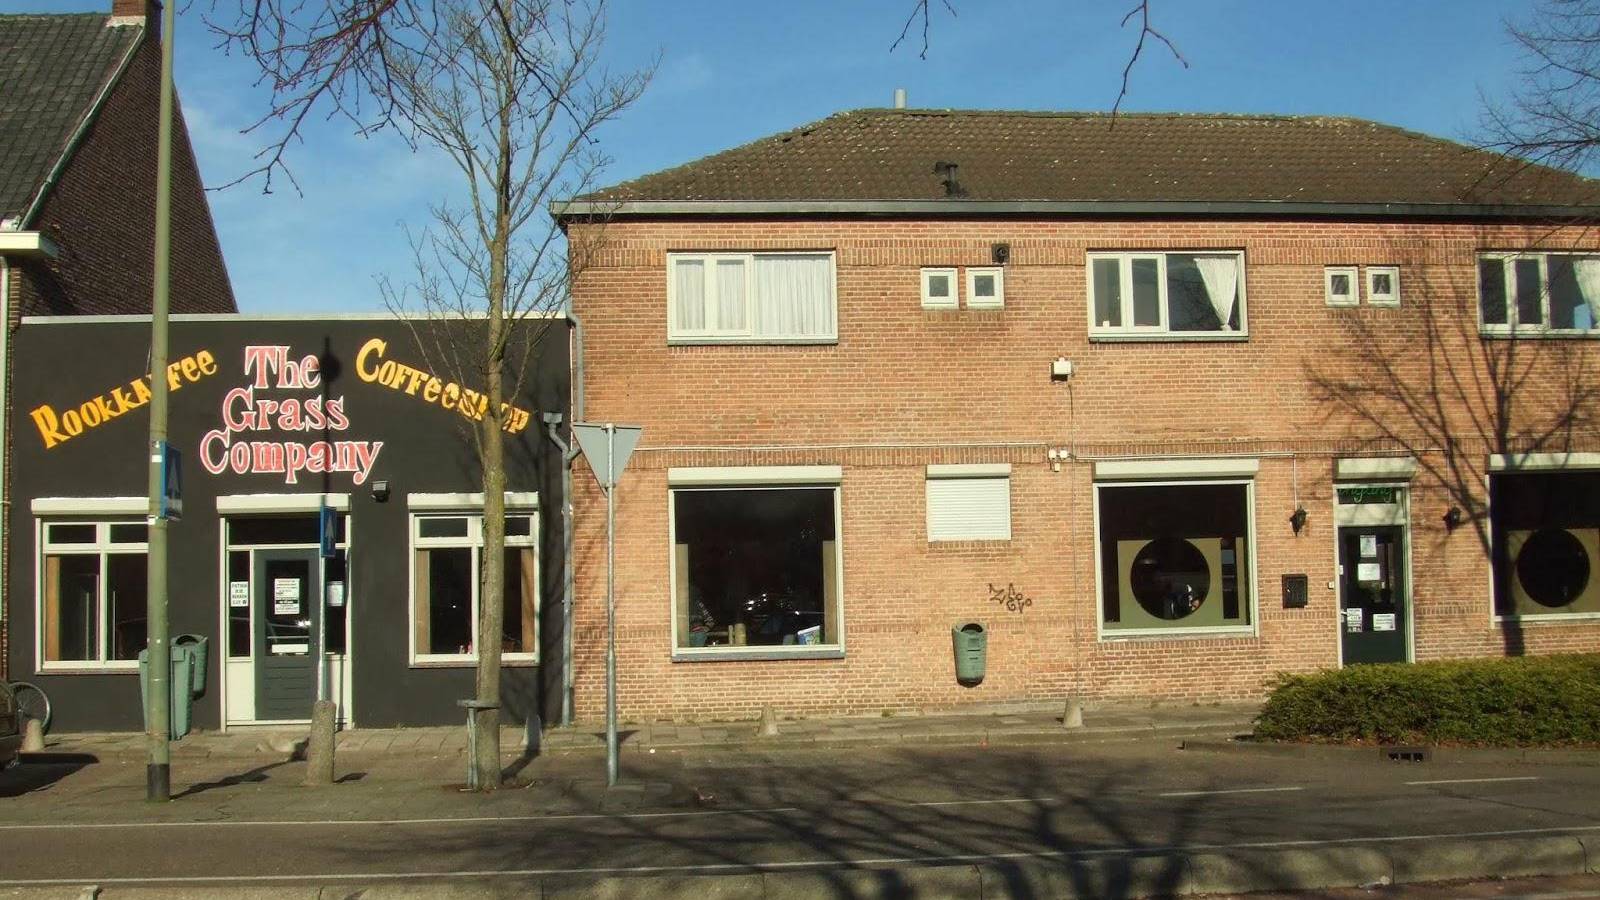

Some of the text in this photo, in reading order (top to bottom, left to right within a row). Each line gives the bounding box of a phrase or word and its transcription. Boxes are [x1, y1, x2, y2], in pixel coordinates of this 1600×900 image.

[244, 345, 321, 389] The
[30, 349, 217, 449] Rookkafee
[222, 384, 350, 432] Grass
[200, 427, 384, 485] Company
